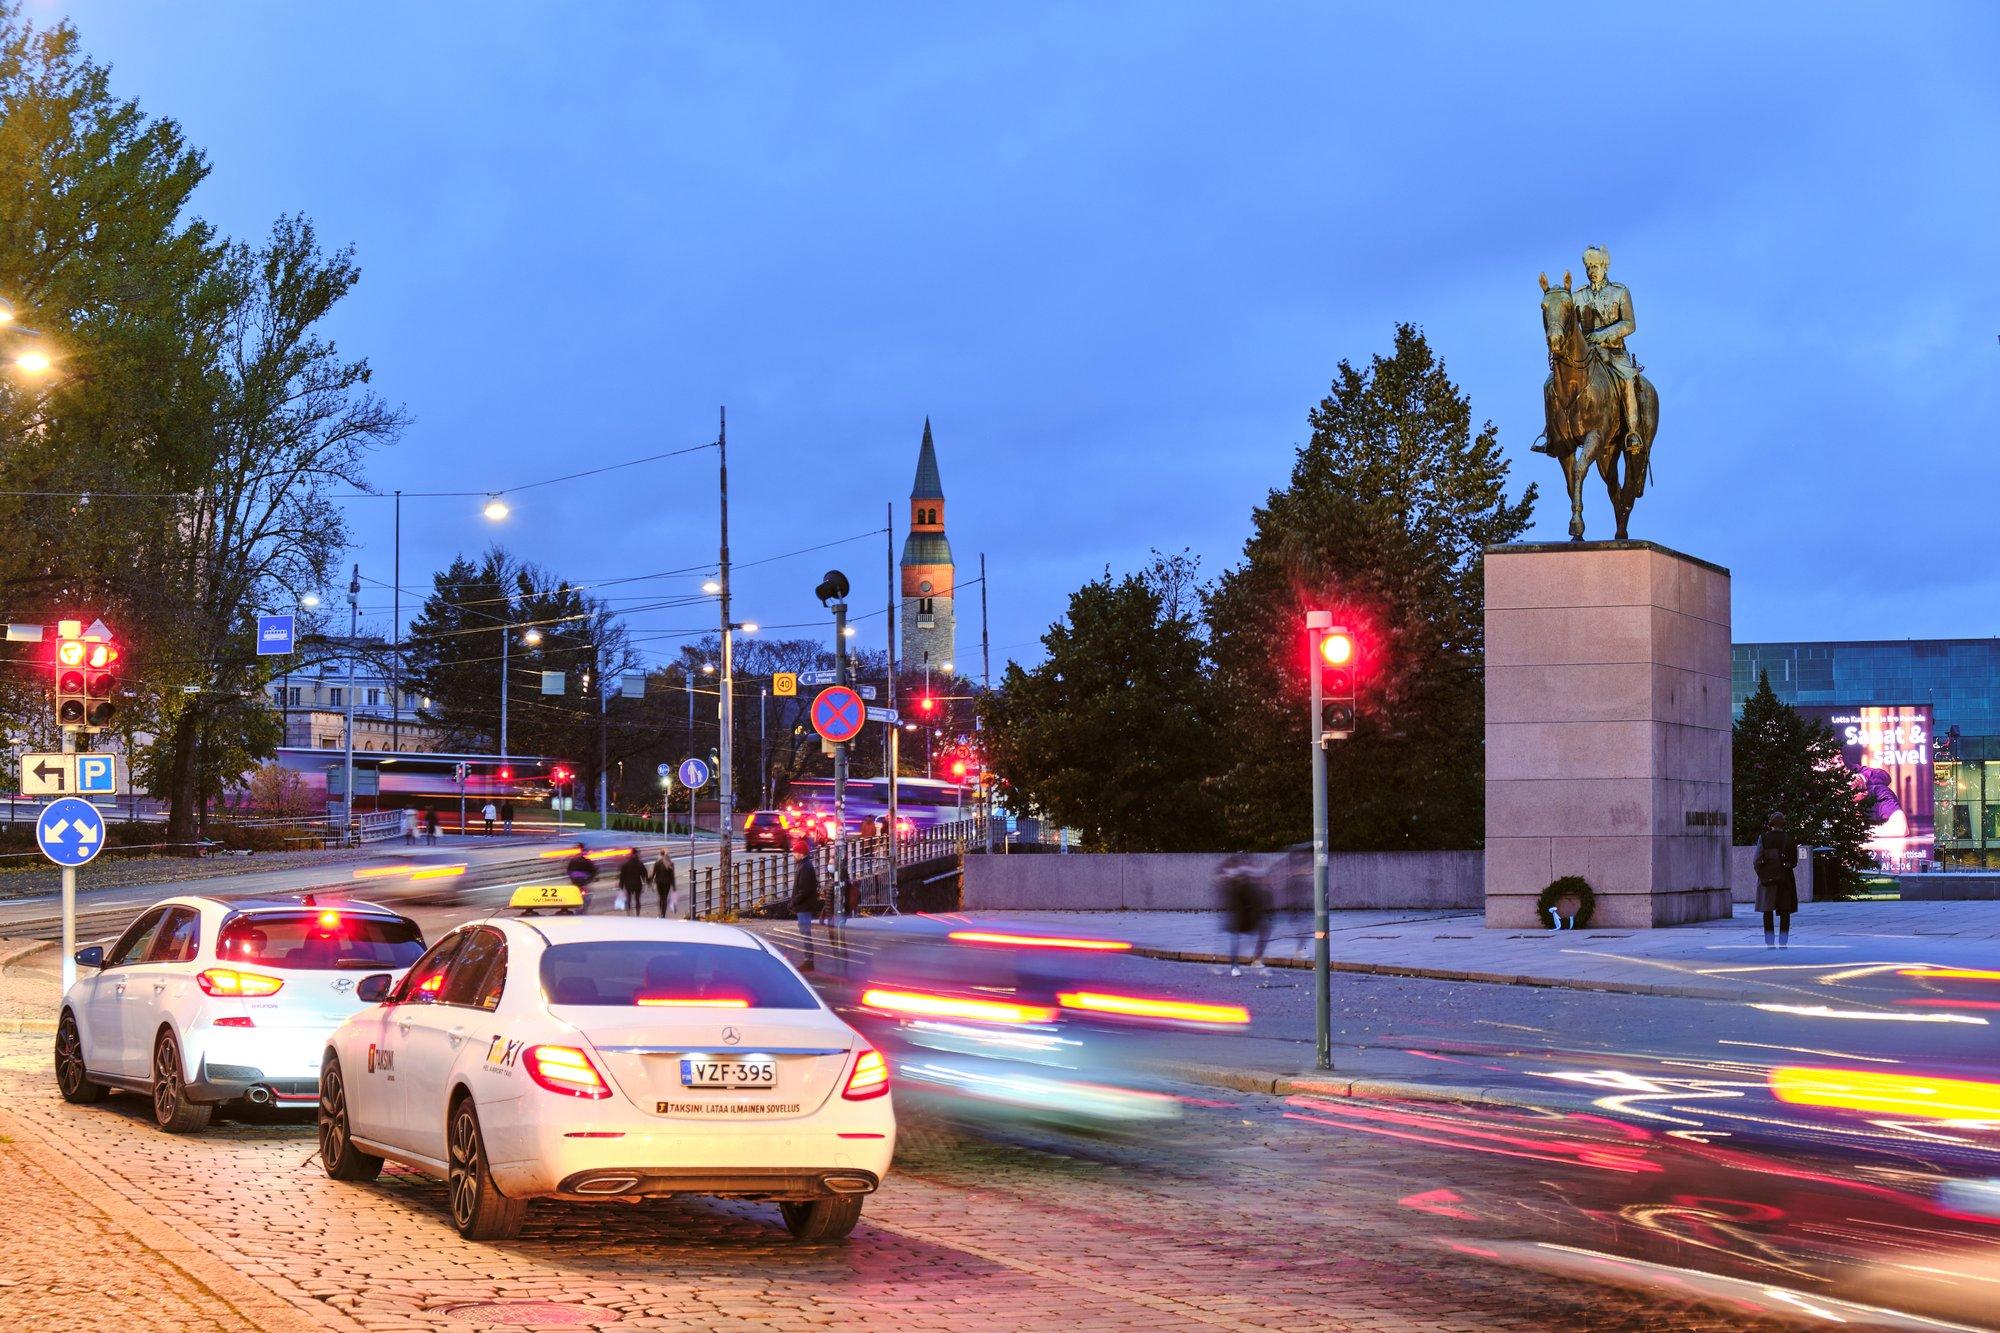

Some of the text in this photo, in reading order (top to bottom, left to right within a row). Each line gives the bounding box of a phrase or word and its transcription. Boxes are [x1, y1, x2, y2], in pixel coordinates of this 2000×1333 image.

[779, 680, 790, 689] 40
[1909, 725, 1926, 744] &
[1874, 745, 1927, 765] sävel
[84, 760, 106, 788] P
[1881, 850, 1927, 859] Korttisali
[486, 1034, 524, 1067] TAXI
[706, 1104, 729, 1114] LATAA
[730, 1104, 765, 1114] ILMAINEN
[766, 1103, 800, 1113] SOVELLUS
